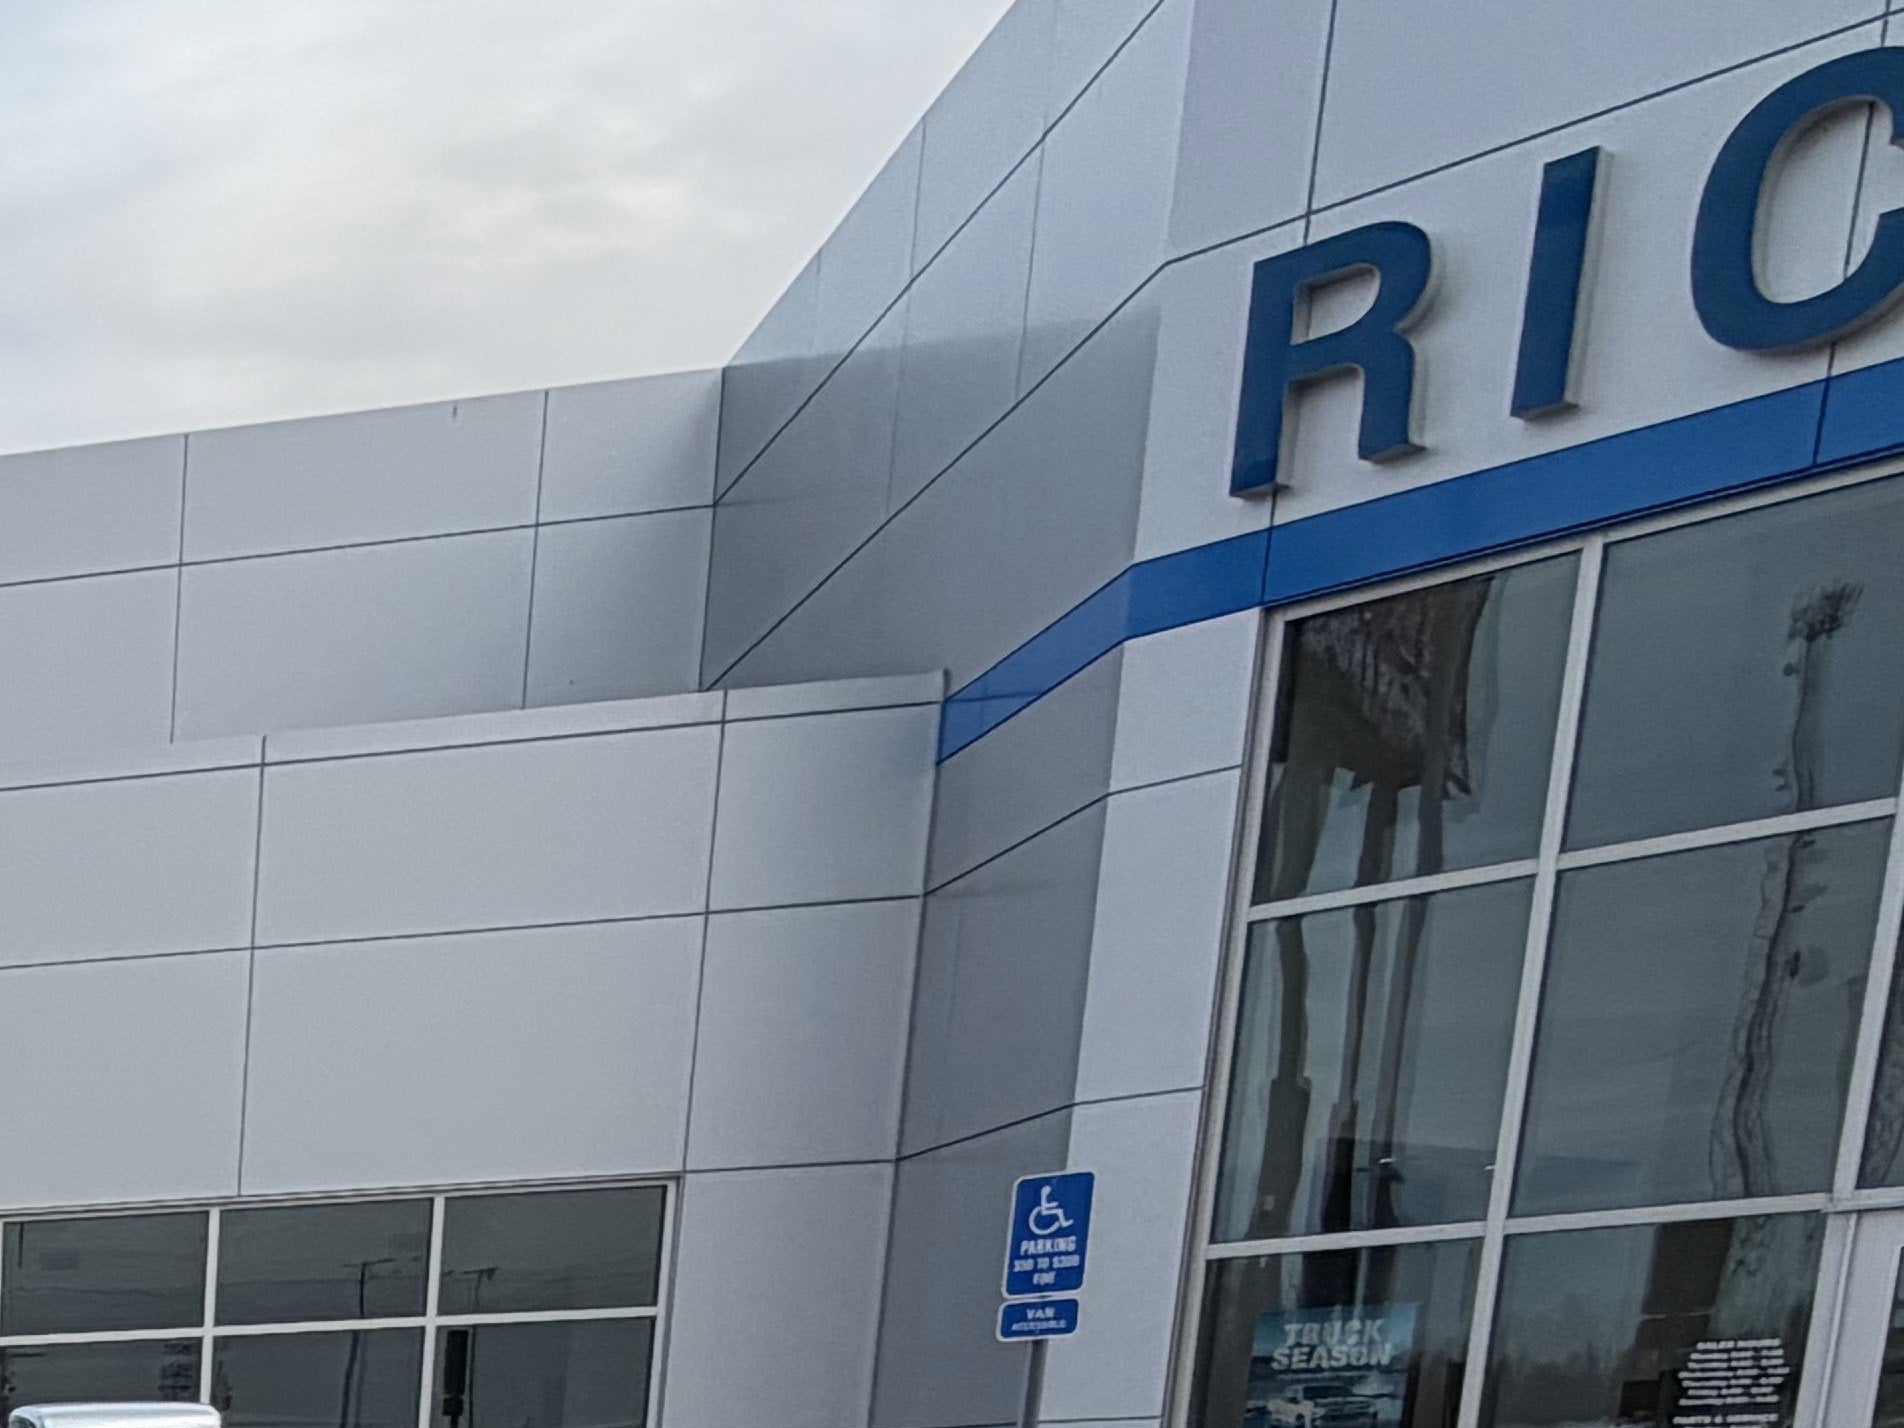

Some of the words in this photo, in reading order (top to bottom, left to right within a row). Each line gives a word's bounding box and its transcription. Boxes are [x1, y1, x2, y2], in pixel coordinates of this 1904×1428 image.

[1021, 1236, 1077, 1255] PARKING
[1026, 1307, 1055, 1320] VAN
[1284, 1318, 1385, 1347] TRUCK
[1270, 1342, 1394, 1370] SEASON
